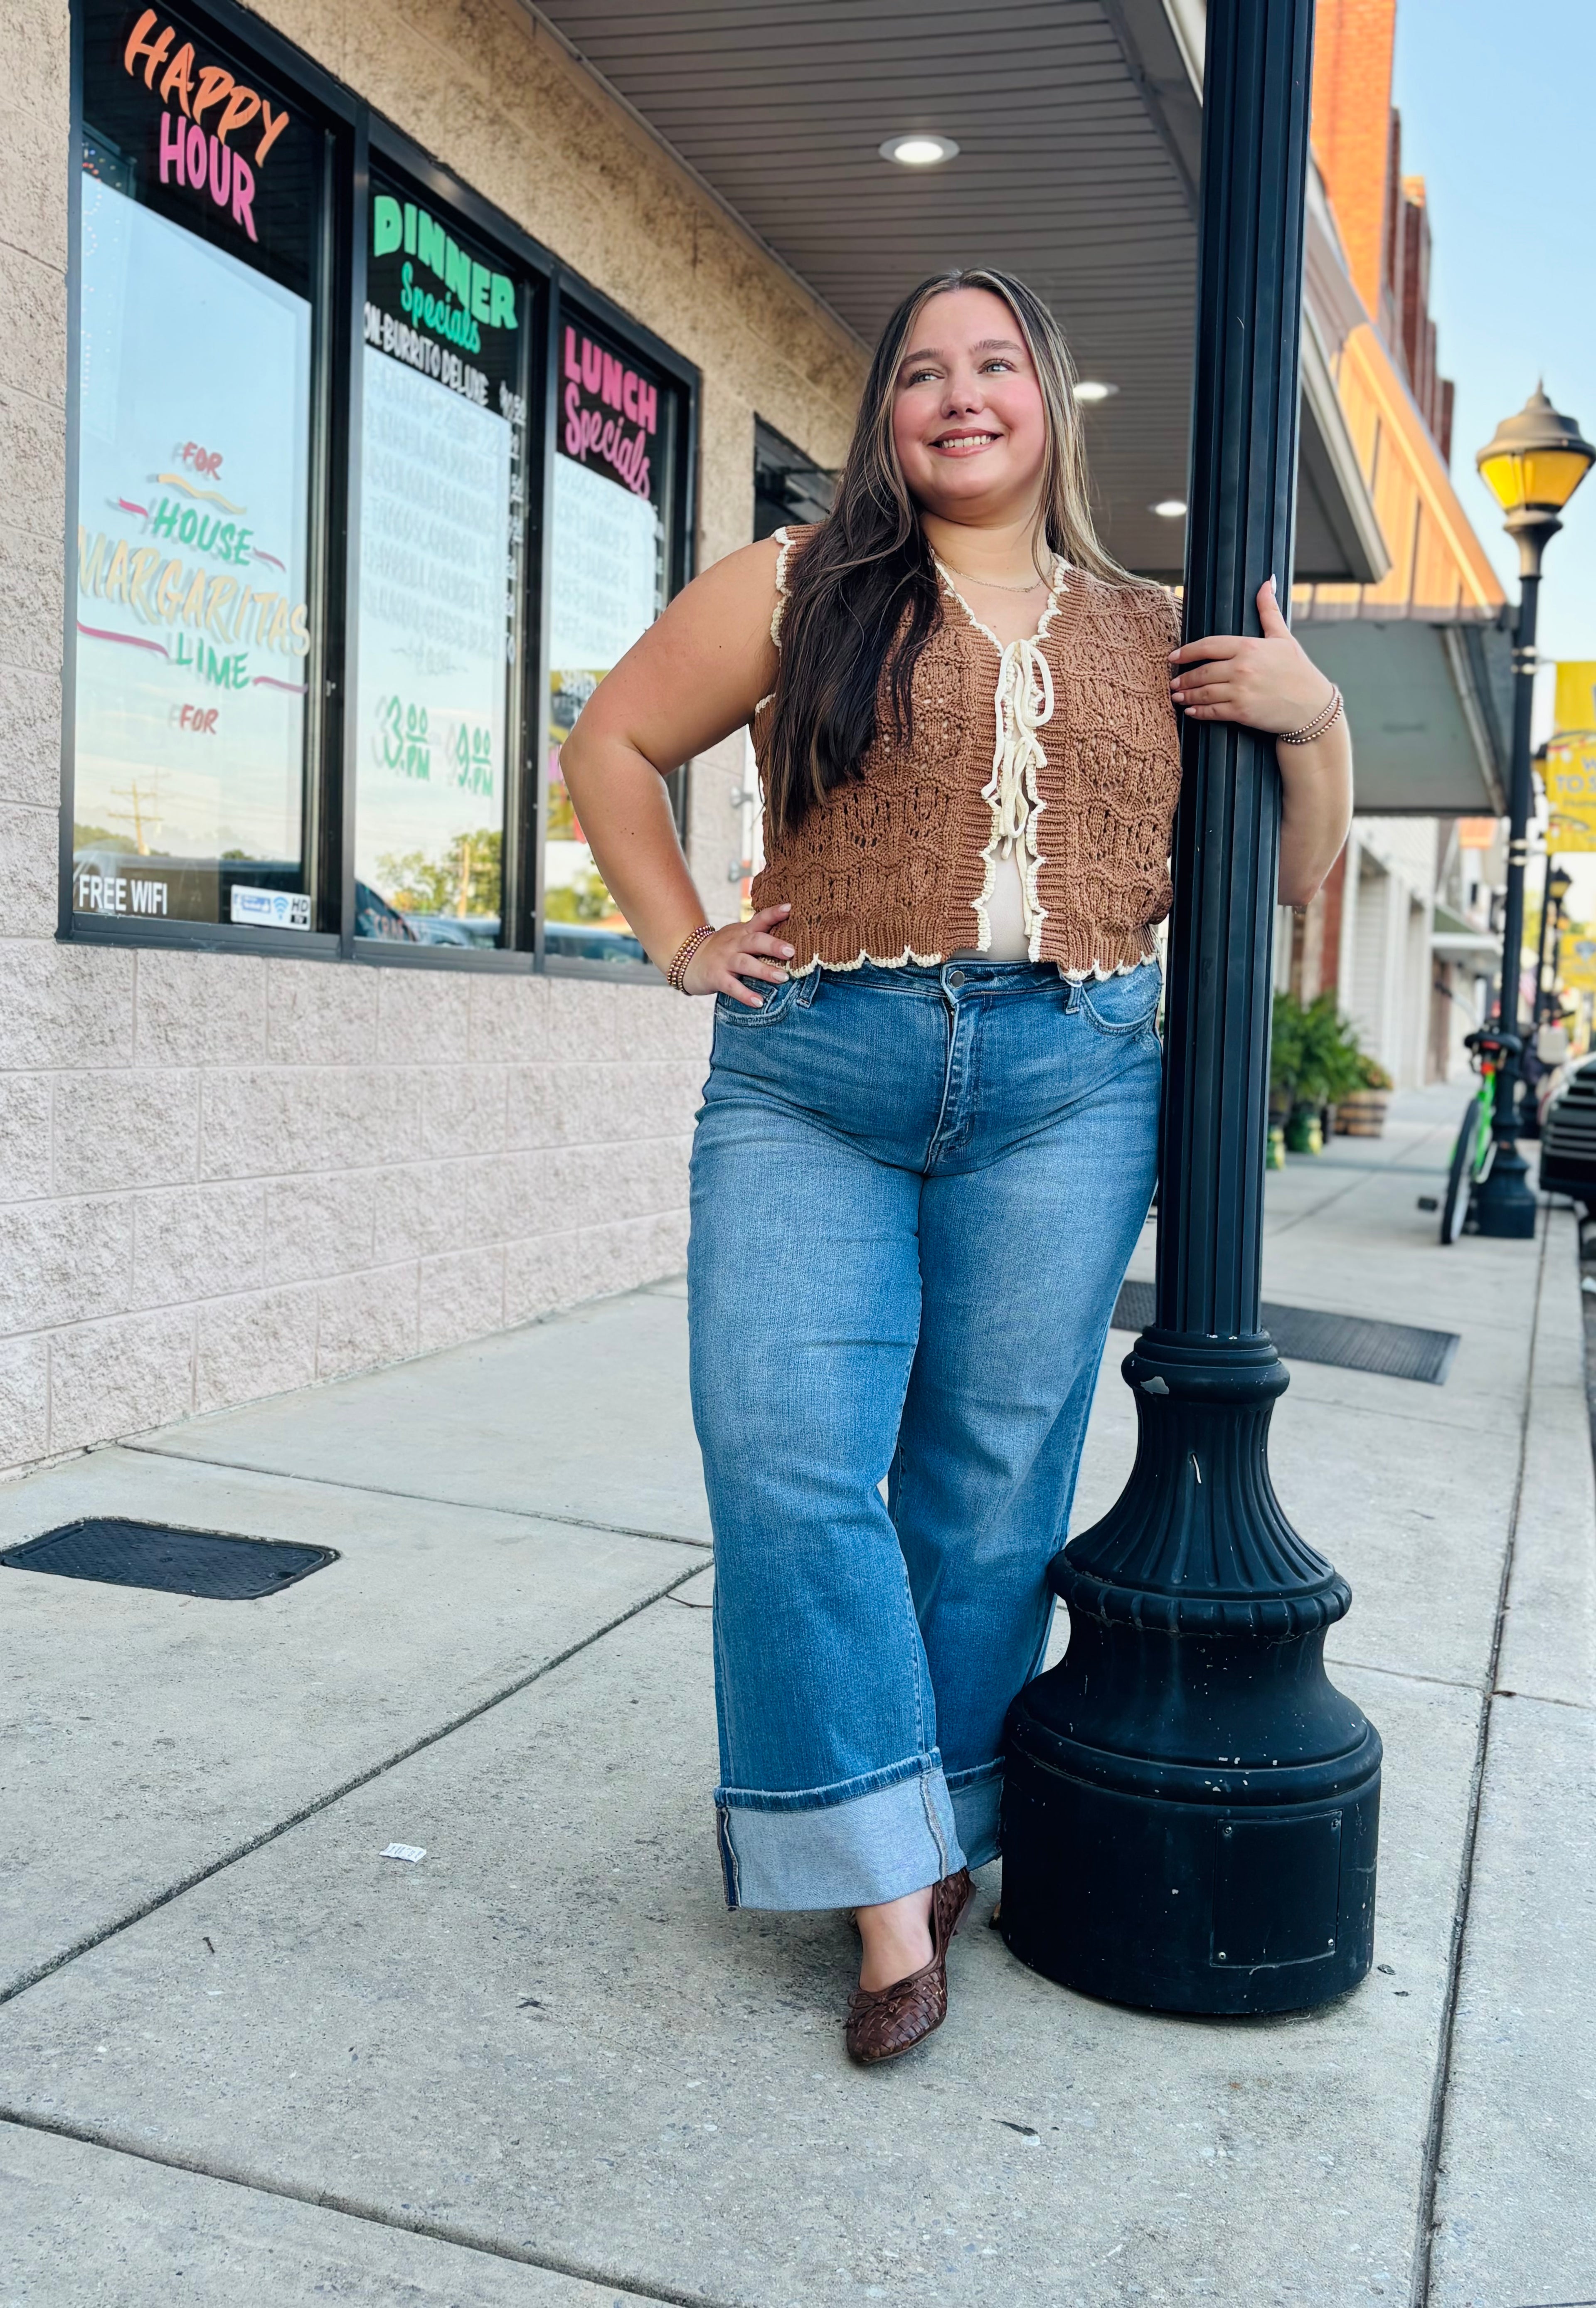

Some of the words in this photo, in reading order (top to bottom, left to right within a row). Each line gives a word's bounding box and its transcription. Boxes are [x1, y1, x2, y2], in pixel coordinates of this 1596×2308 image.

[124, 9, 289, 168] HAPPY
[160, 111, 258, 243] HOUR
[374, 195, 518, 329] DINNER
[401, 261, 481, 354] Specials
[564, 325, 657, 435] LUNCH
[183, 441, 224, 480] FOR
[564, 382, 651, 501] Specials
[152, 497, 254, 566] HOUSE
[78, 525, 311, 657] MARGARITAS
[176, 632, 250, 690] LIME
[180, 704, 219, 735] FOR
[79, 874, 128, 911] FREE
[130, 879, 168, 915] WIFI
[291, 897, 309, 912] HD
